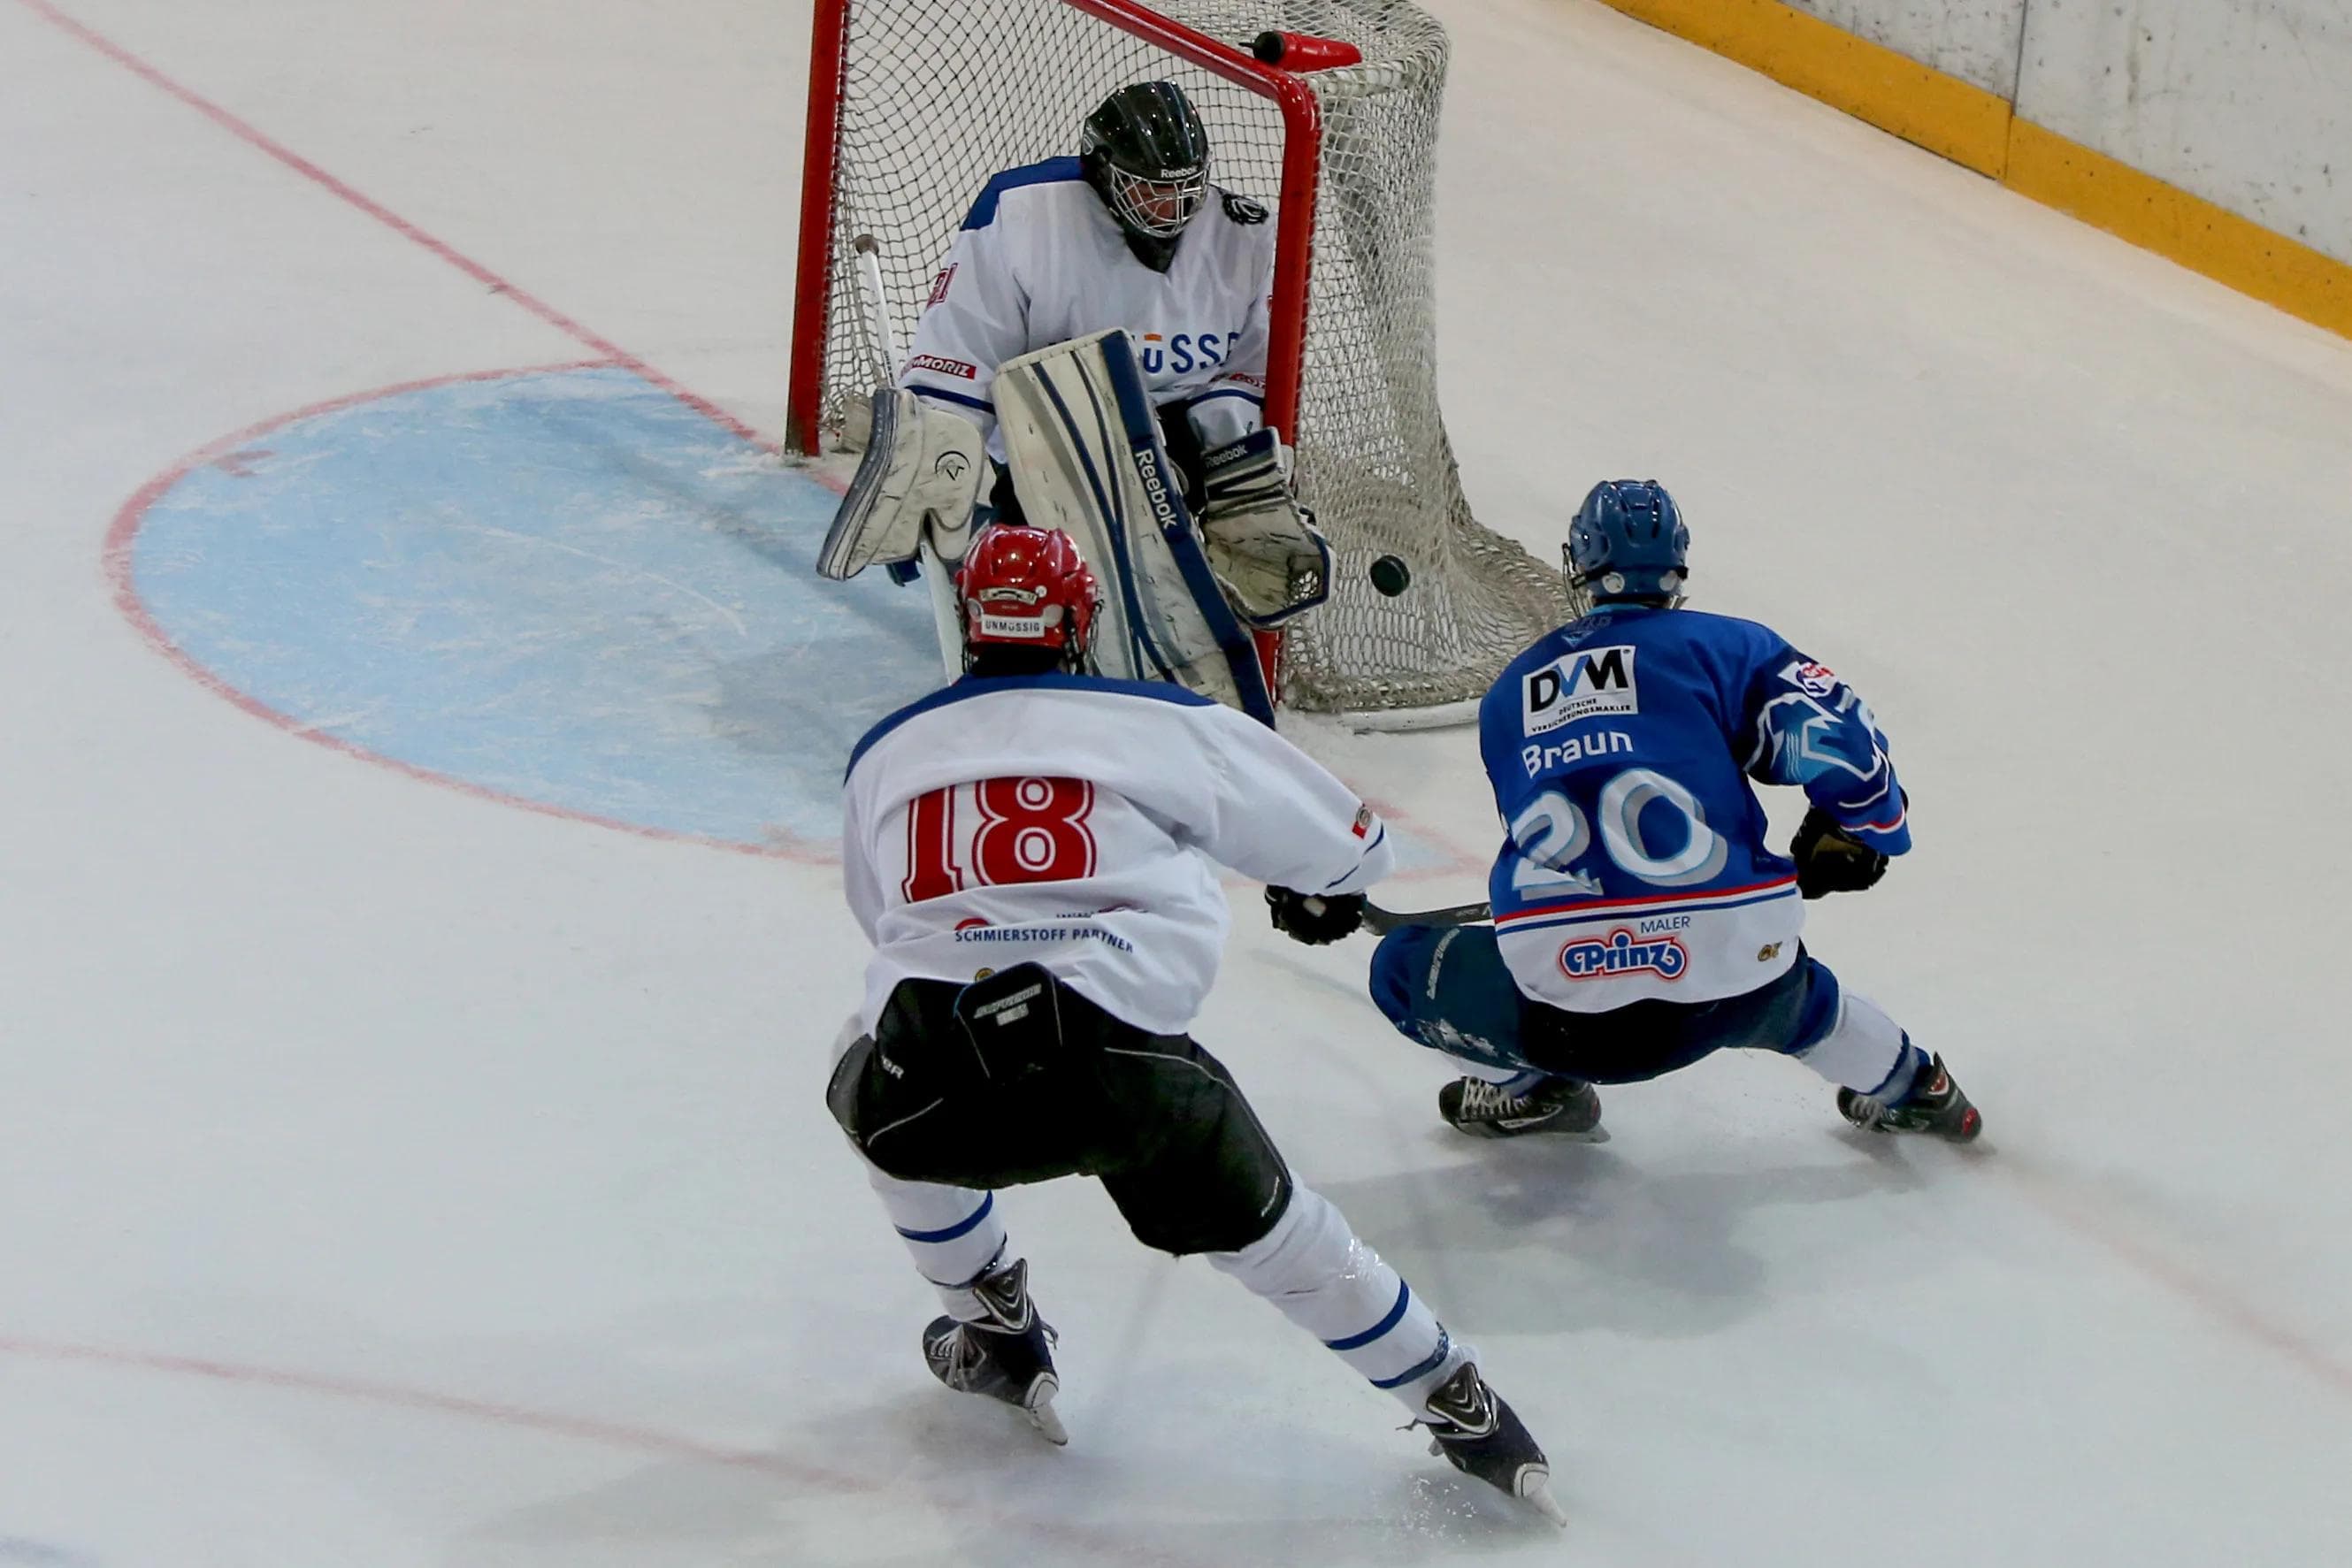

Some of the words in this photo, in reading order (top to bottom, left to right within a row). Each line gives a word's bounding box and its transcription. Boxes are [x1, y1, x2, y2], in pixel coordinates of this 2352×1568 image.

[1161, 164, 1199, 178] Reebok
[1205, 445, 1248, 469] Reebok
[1135, 448, 1177, 530] Reebok
[1529, 648, 1629, 713] DVM
[1521, 730, 1635, 779] Braun
[901, 776, 1098, 904] 18
[1511, 767, 1728, 902] 20
[955, 928, 1067, 943] SCHMIERSTOFF
[1072, 928, 1134, 954] PARTNER
[1641, 916, 1691, 934] MALER
[1562, 932, 1684, 976] Prinz
